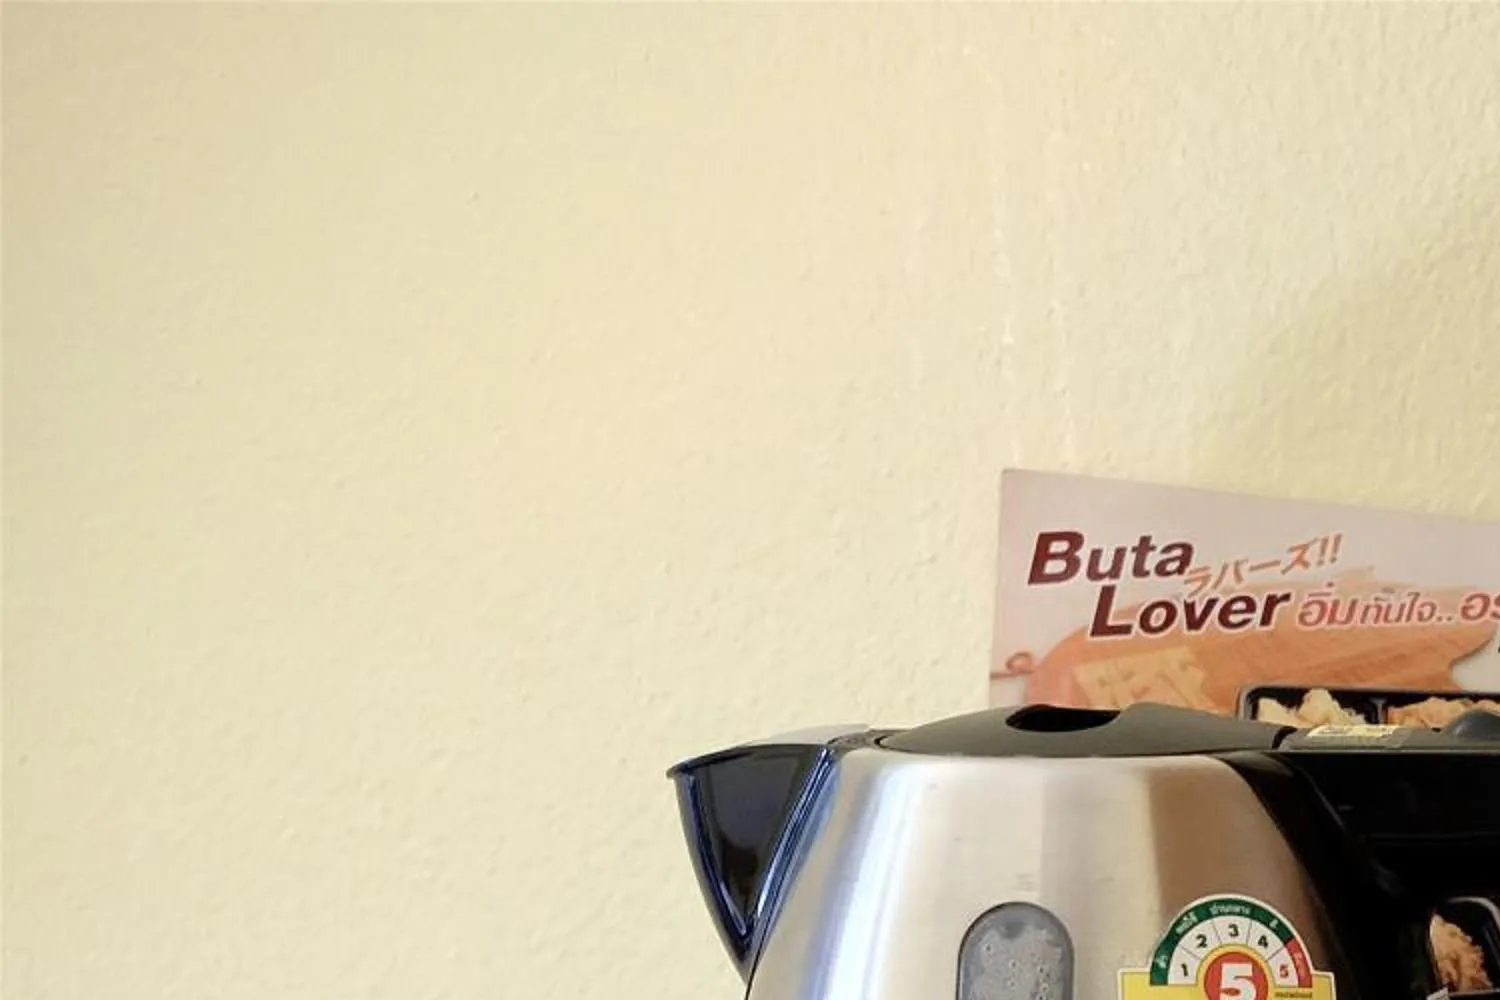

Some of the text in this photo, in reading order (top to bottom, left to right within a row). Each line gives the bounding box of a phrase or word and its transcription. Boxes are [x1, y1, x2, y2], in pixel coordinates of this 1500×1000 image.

[1028, 531, 1195, 585] Buta
[1089, 584, 1291, 638] Lover
[1180, 924, 1289, 978] 1 2 3 4 5
